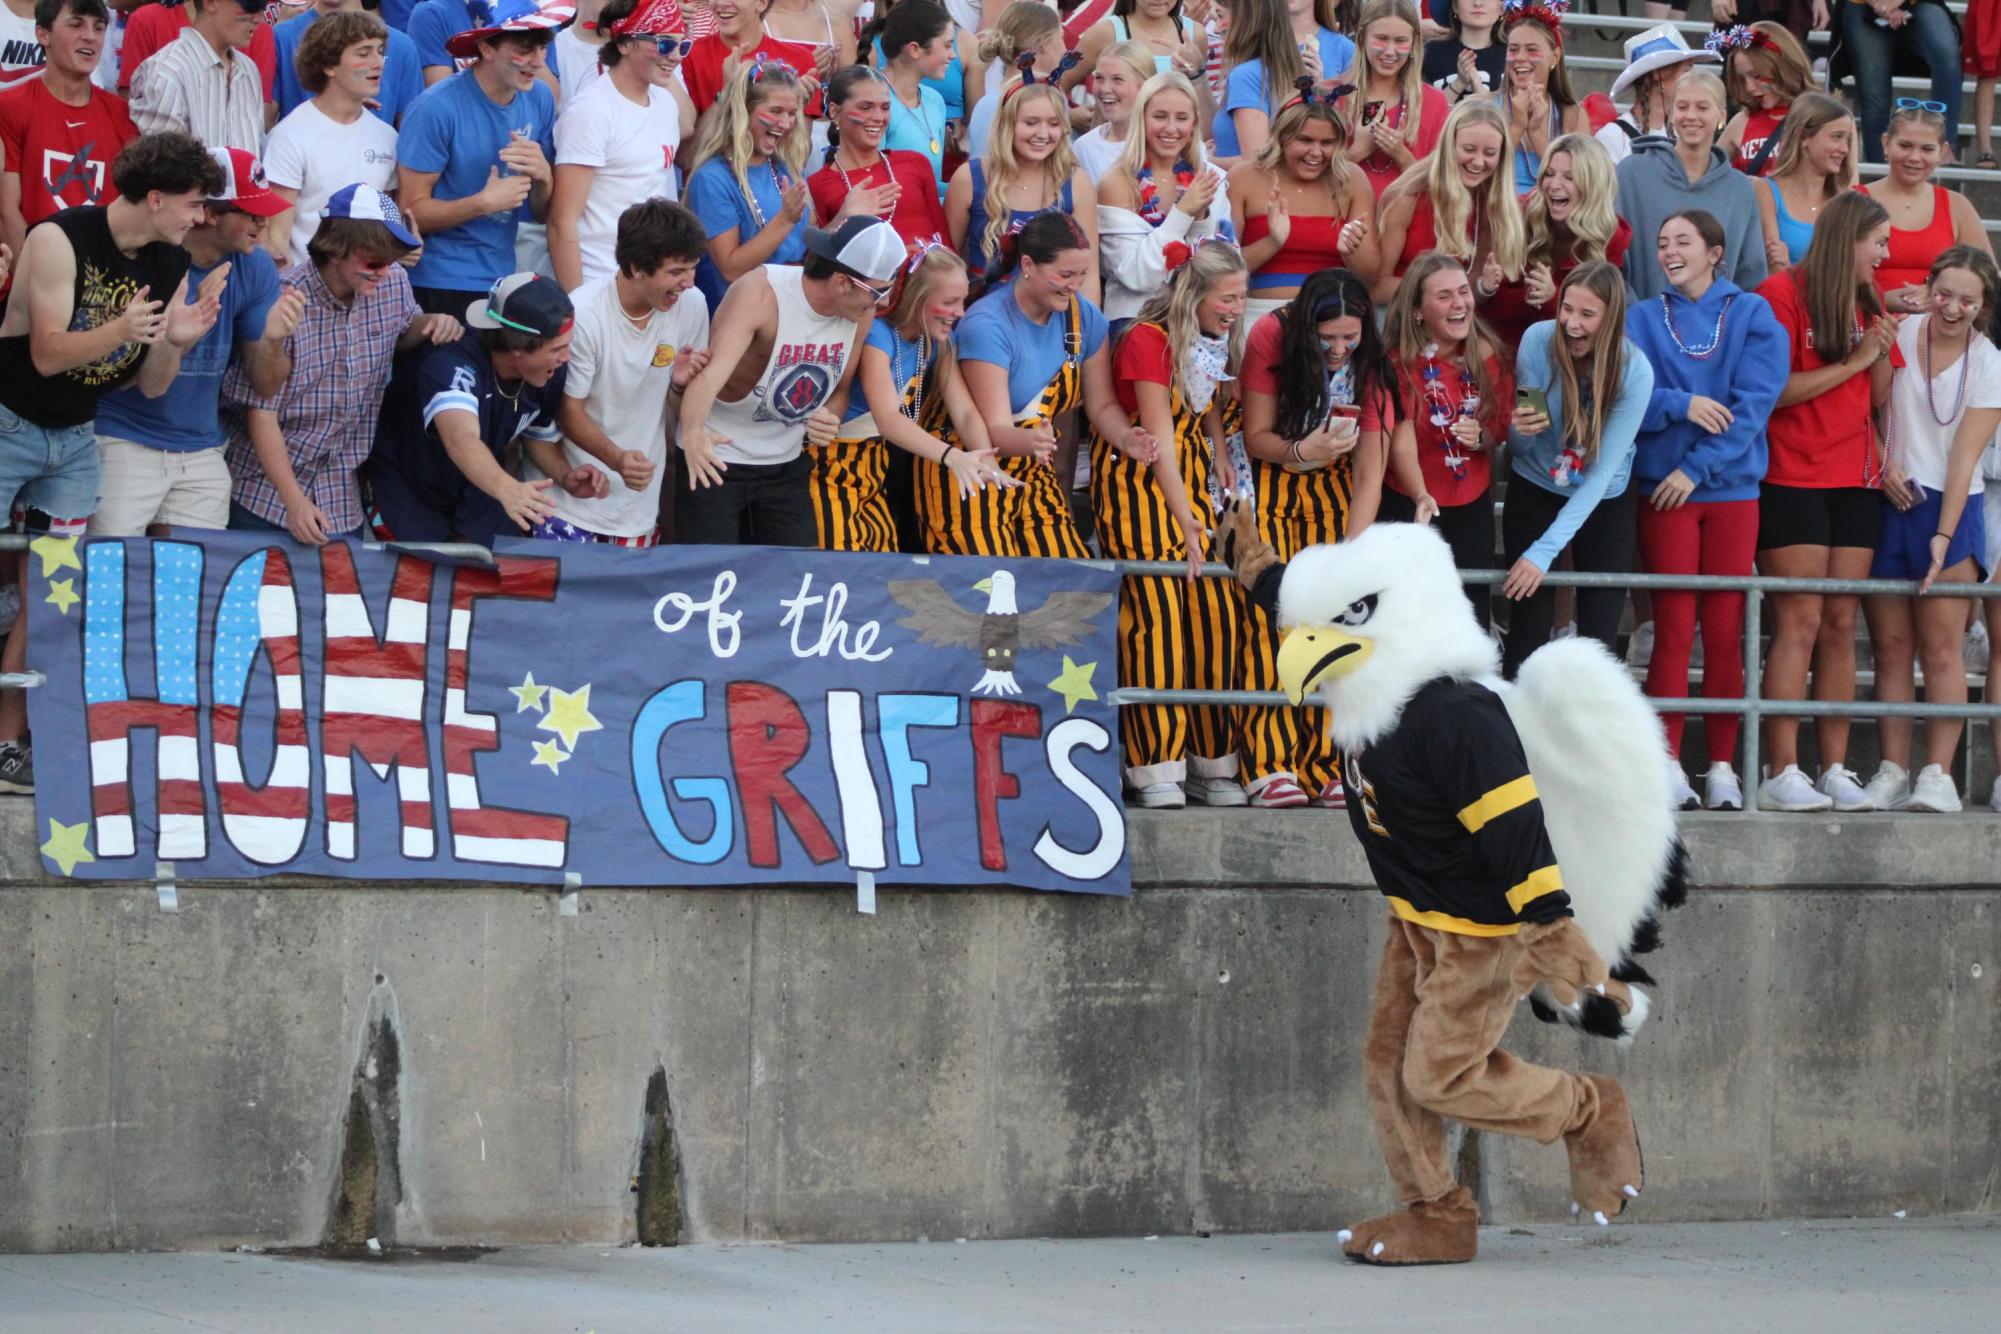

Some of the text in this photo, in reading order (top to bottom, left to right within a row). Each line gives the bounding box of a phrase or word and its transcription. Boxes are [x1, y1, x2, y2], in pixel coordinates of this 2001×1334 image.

[449, 365, 476, 393] R
[791, 377, 814, 410] 8
[653, 570, 893, 662] of the
[80, 539, 571, 868] HOME
[630, 678, 1126, 881] GRIFFS
